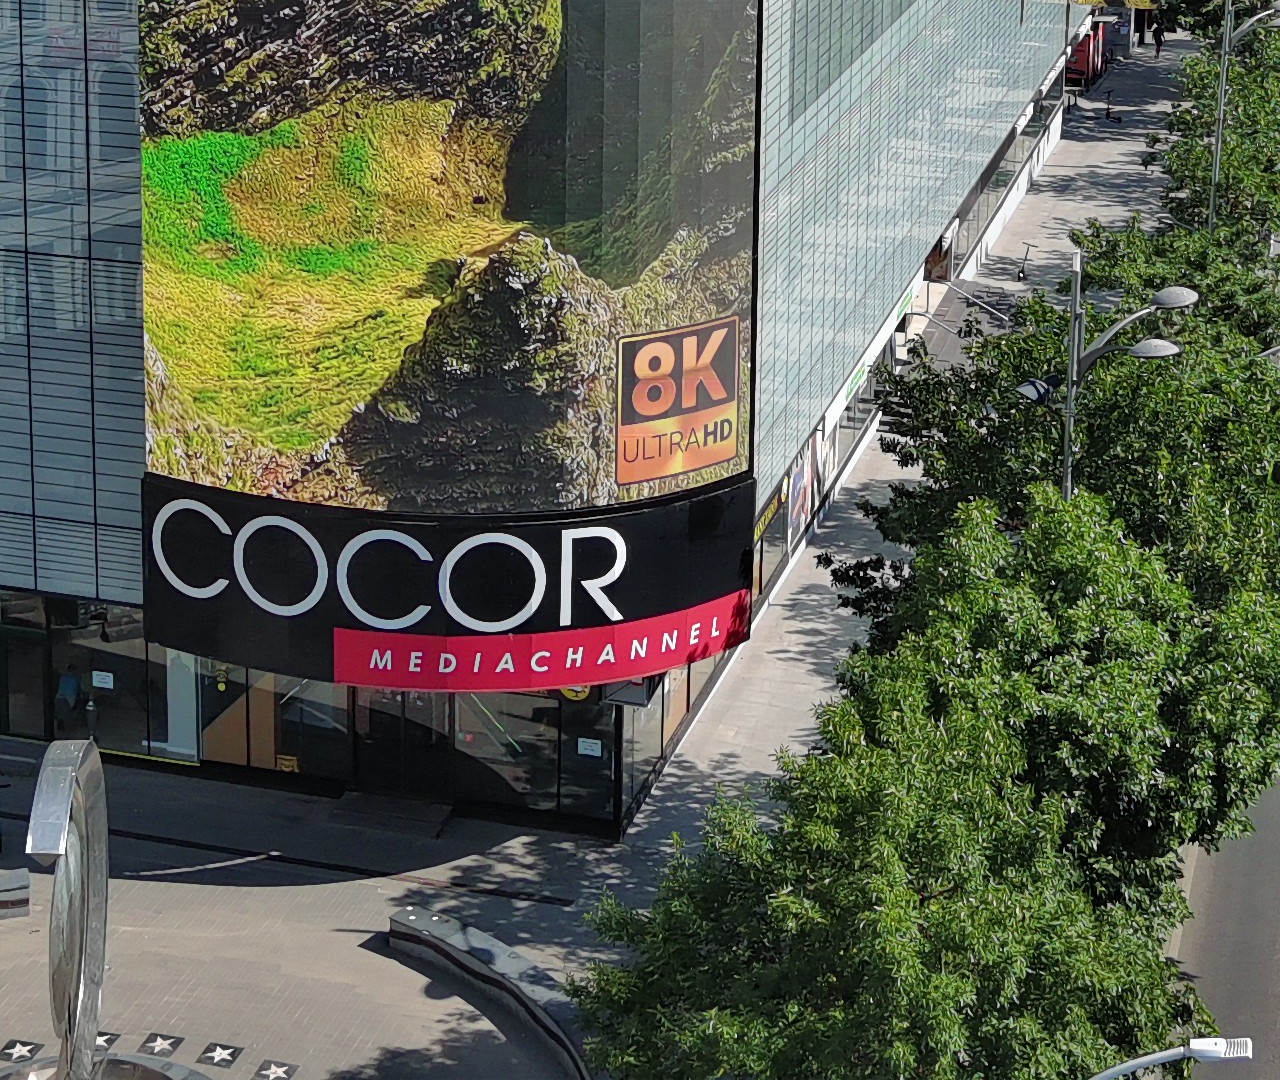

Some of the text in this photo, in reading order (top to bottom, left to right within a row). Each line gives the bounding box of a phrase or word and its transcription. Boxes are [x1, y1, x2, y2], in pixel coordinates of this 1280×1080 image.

[631, 327, 729, 417] 8K
[152, 498, 628, 633] COCOR
[369, 615, 721, 675] MEDIACHANNEL
